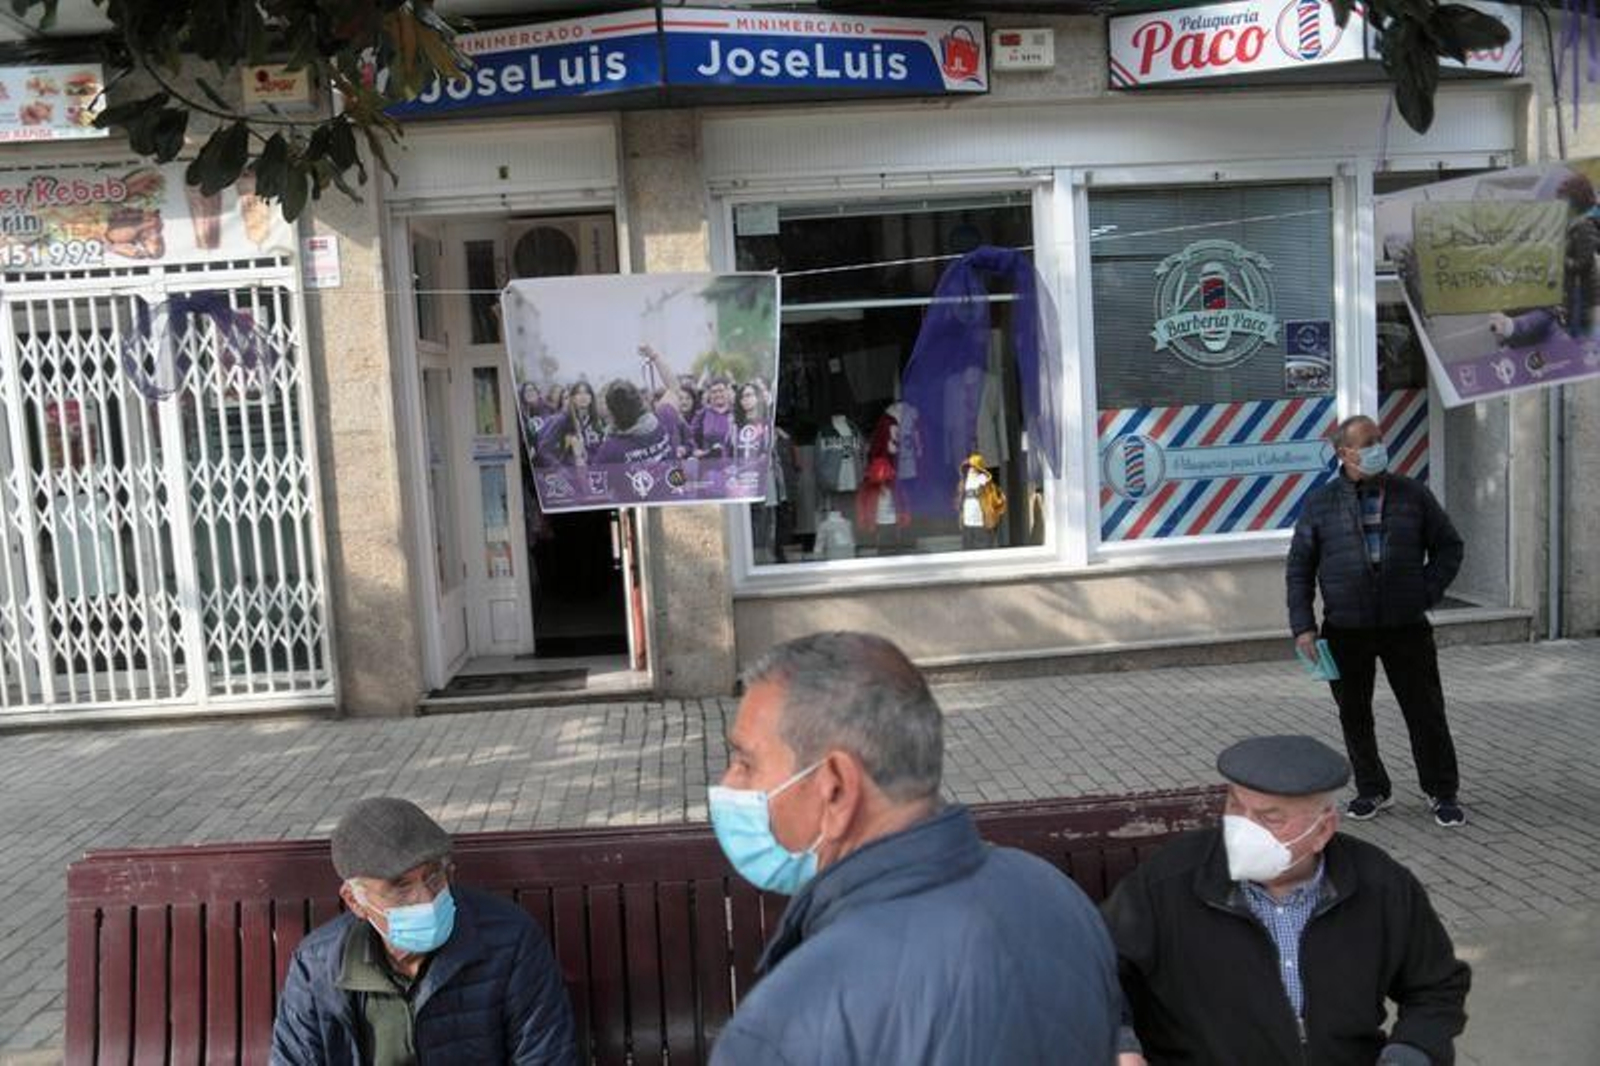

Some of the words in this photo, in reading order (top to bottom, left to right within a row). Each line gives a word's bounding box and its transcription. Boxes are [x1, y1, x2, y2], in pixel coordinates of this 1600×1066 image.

[736, 18, 865, 34] MINIMERCADO
[698, 40, 908, 80] JoseLuis
[1132, 21, 1270, 75] Paco
[34, 177, 126, 203] Kebab
[48, 239, 103, 264] 992
[1232, 312, 1267, 332] Paco
